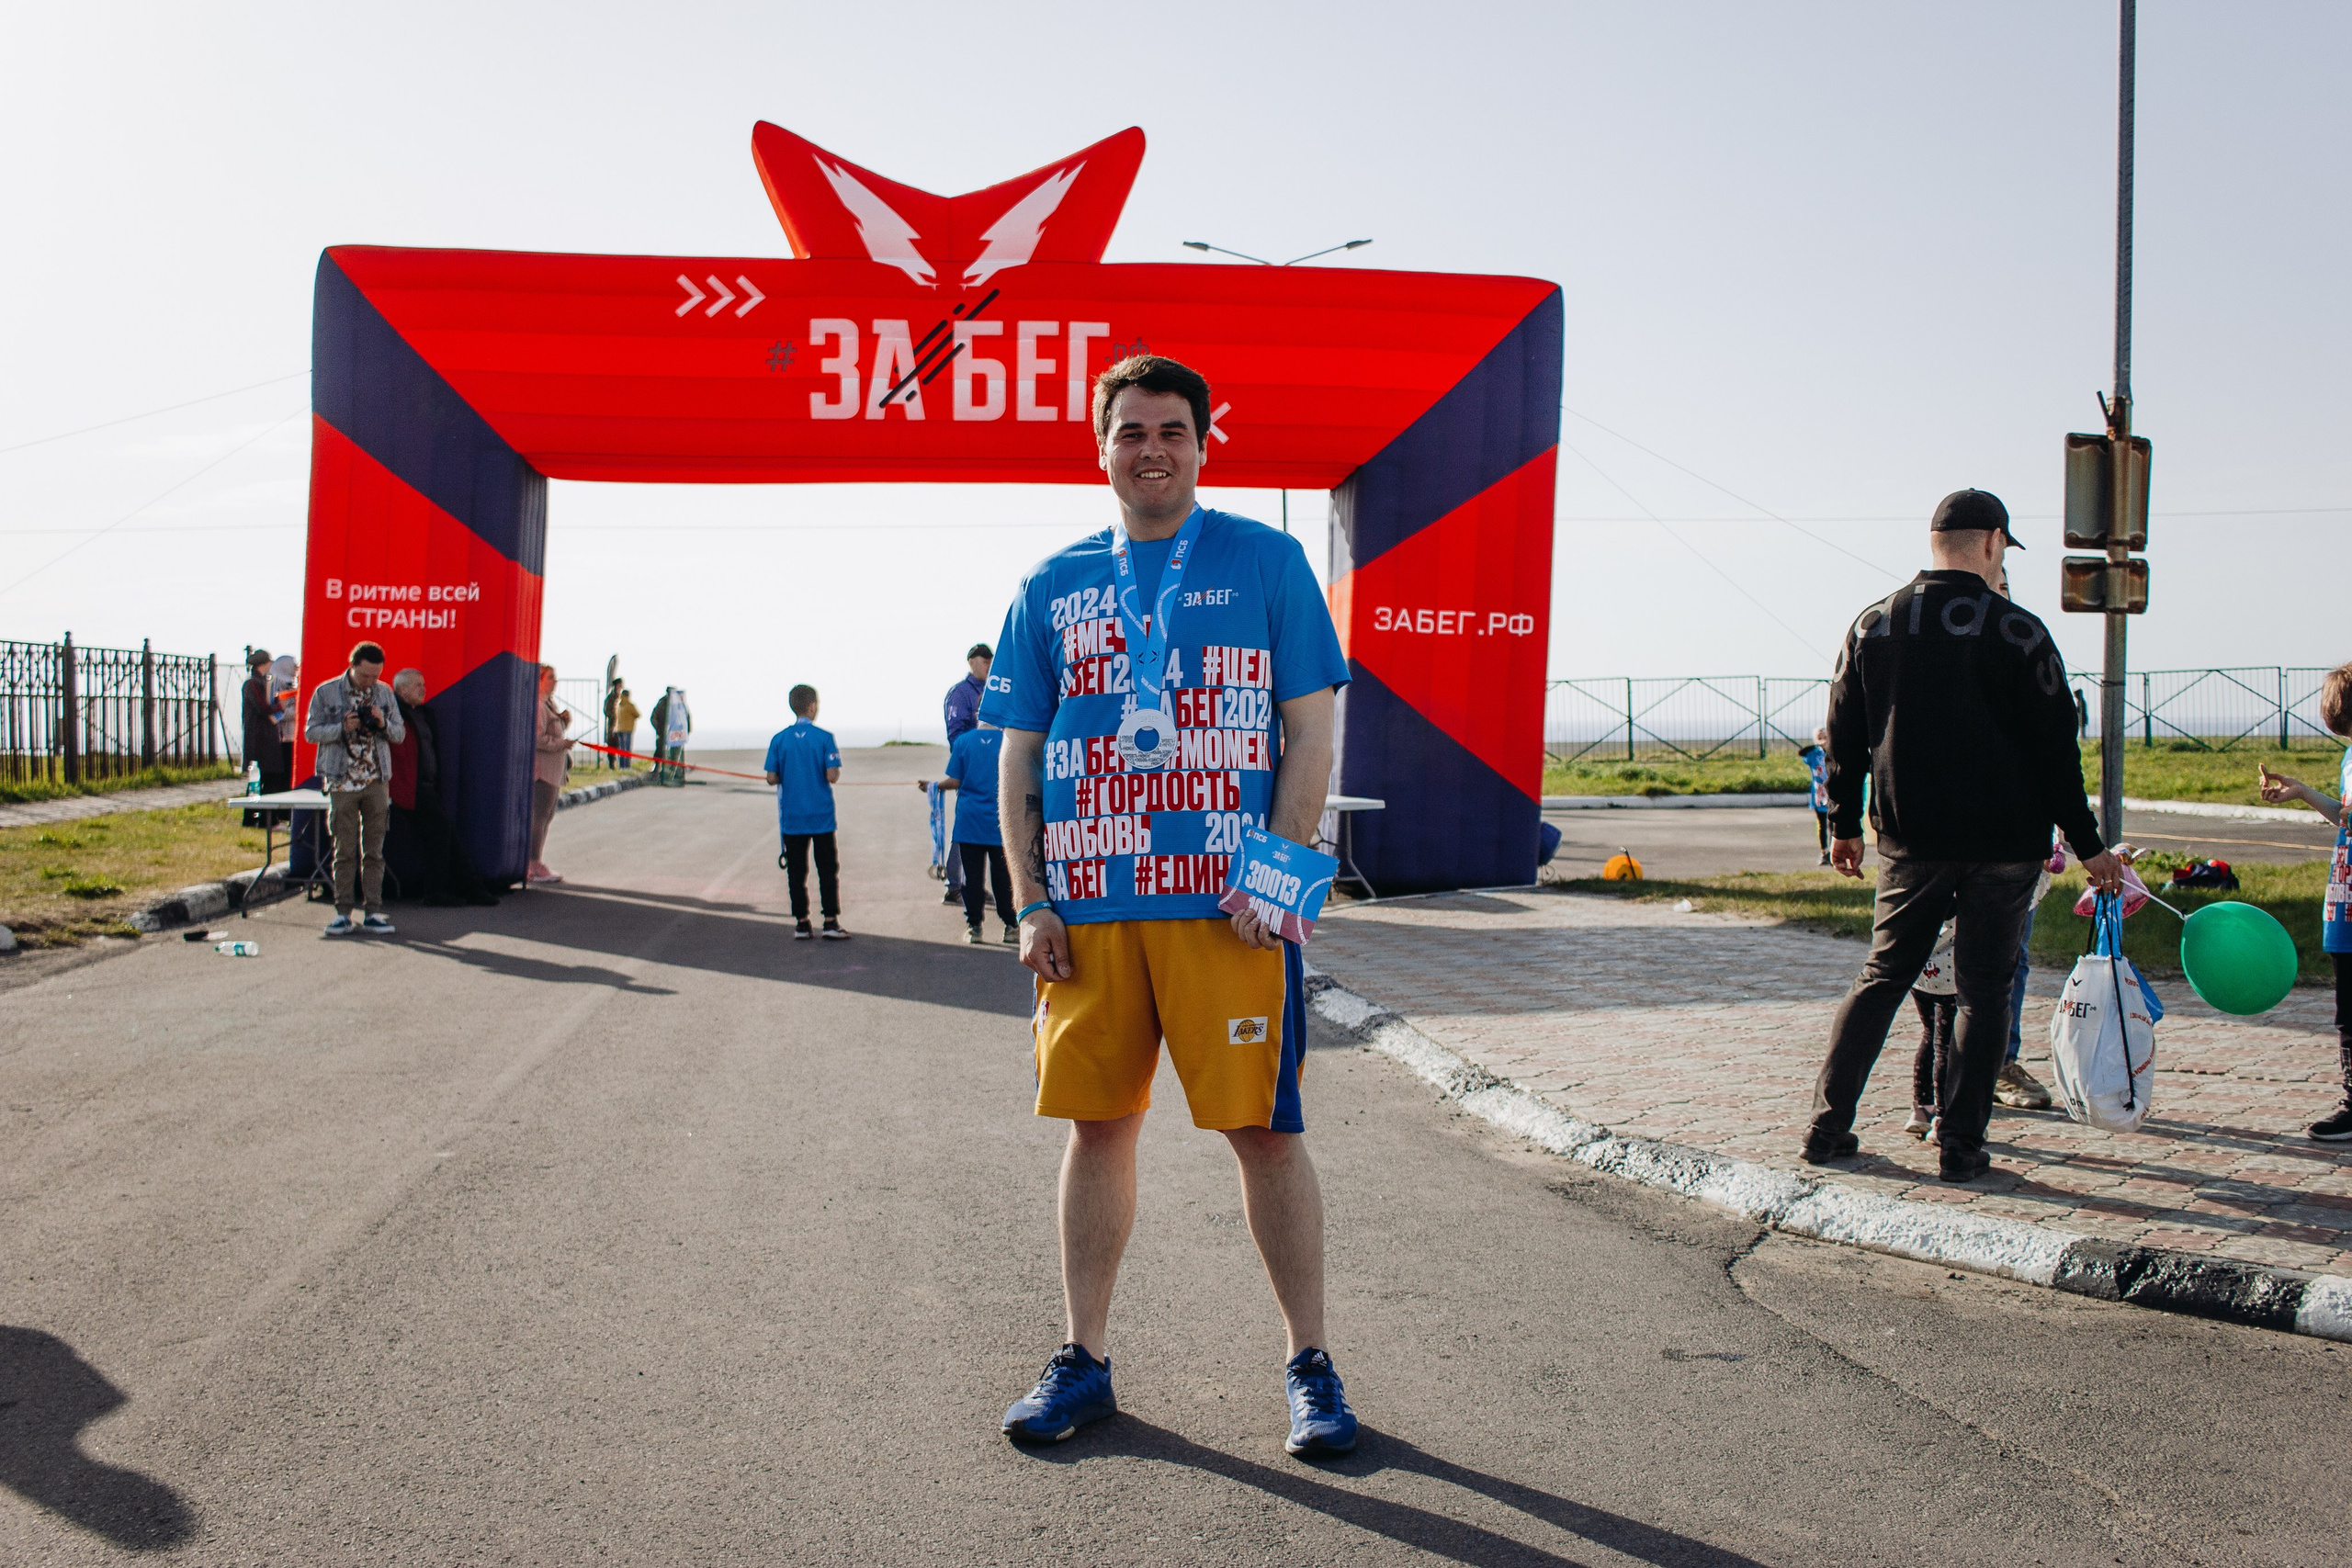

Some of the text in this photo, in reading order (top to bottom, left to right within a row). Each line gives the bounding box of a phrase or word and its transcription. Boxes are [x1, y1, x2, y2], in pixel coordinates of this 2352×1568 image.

[1174, 539, 1189, 558] ПСБ
[1118, 558, 1129, 577] ПСБ
[325, 578, 481, 603] В ритме всей
[346, 606, 457, 629] СТРАНЫ!
[1050, 584, 1118, 633] 2024
[1373, 605, 1535, 637] ЗАБЕГ.РФ
[1075, 770, 1240, 818] #ГОРДОСТЬ
[1253, 832, 1268, 843] ПСБ
[1244, 859, 1302, 907] 30013
